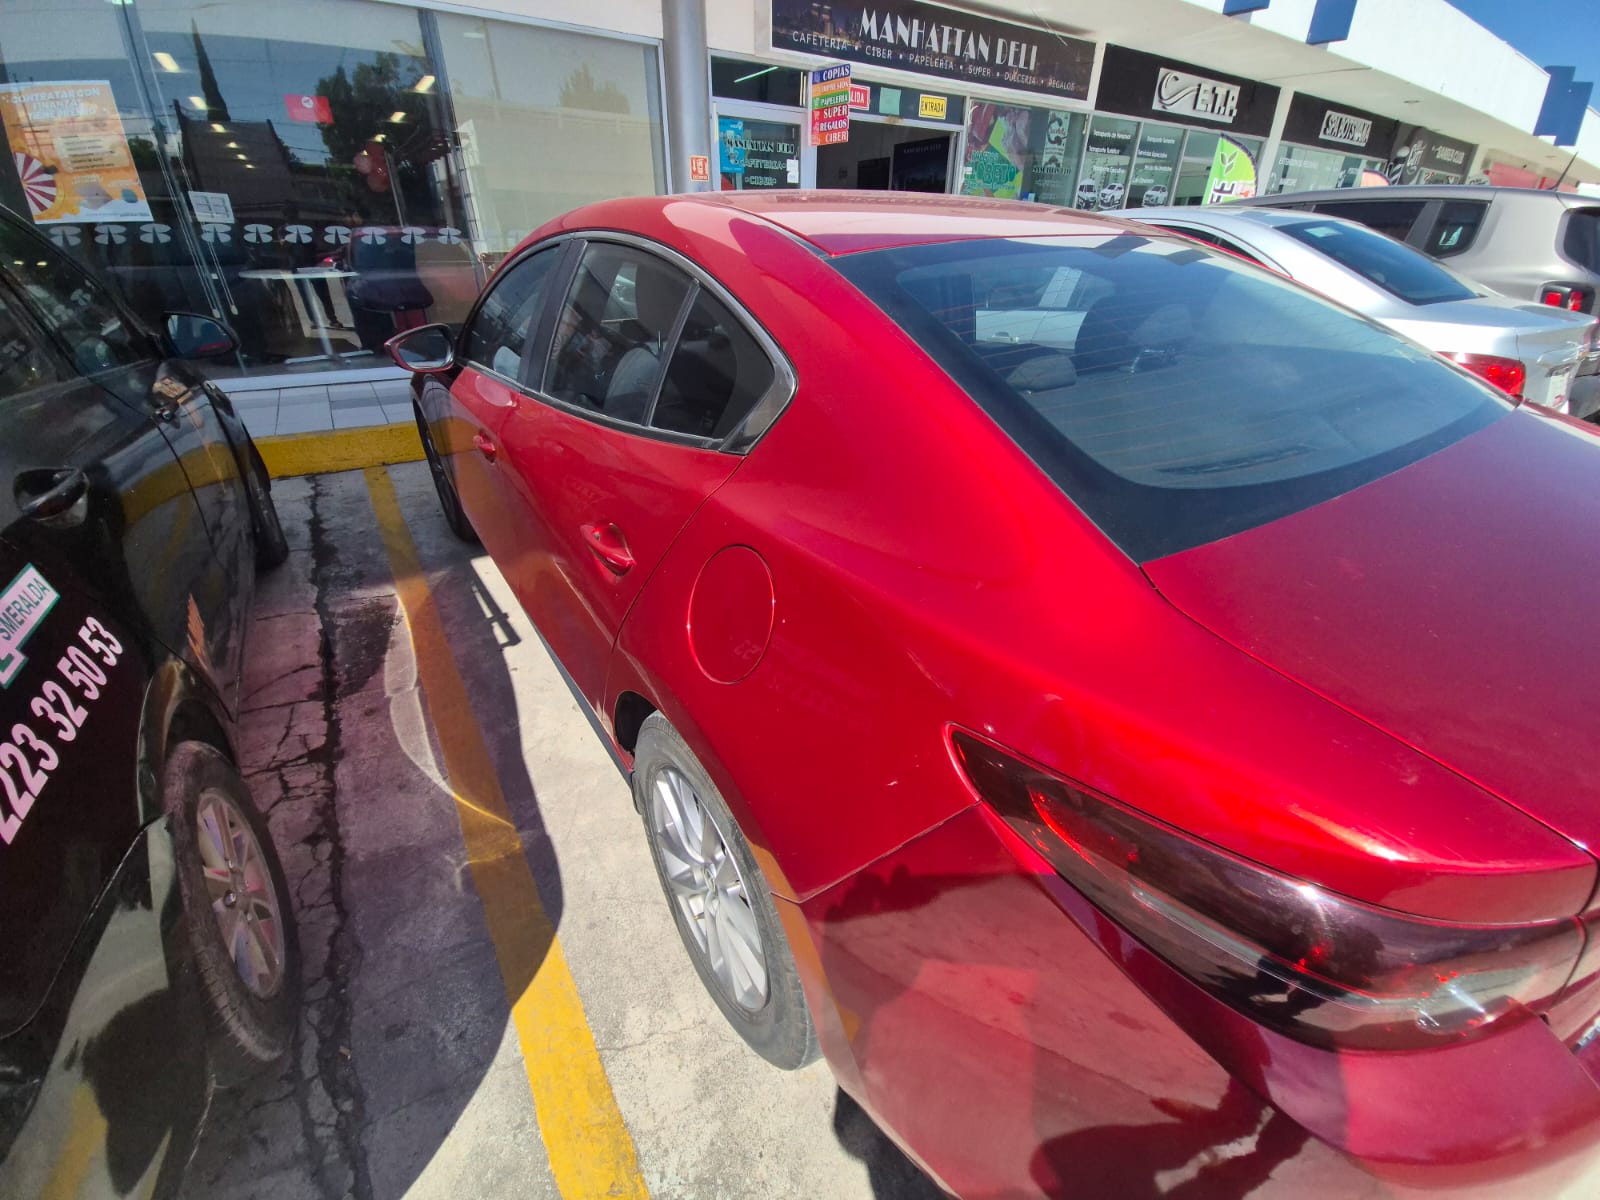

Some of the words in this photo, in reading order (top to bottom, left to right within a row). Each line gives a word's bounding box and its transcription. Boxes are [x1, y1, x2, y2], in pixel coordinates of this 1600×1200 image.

[859, 6, 991, 63] MANHATTAN
[995, 37, 1038, 71] DELI
[822, 65, 850, 81] COPIAS
[865, 45, 892, 60] CIBER
[968, 64, 991, 78] SUPER
[823, 104, 848, 119] SUPER
[921, 100, 944, 113] ENTRADA
[820, 119, 847, 132] REGALOS
[825, 130, 847, 143] CIBER
[78, 616, 124, 667] 53
[57, 645, 107, 701] 50
[31, 680, 89, 742] 32
